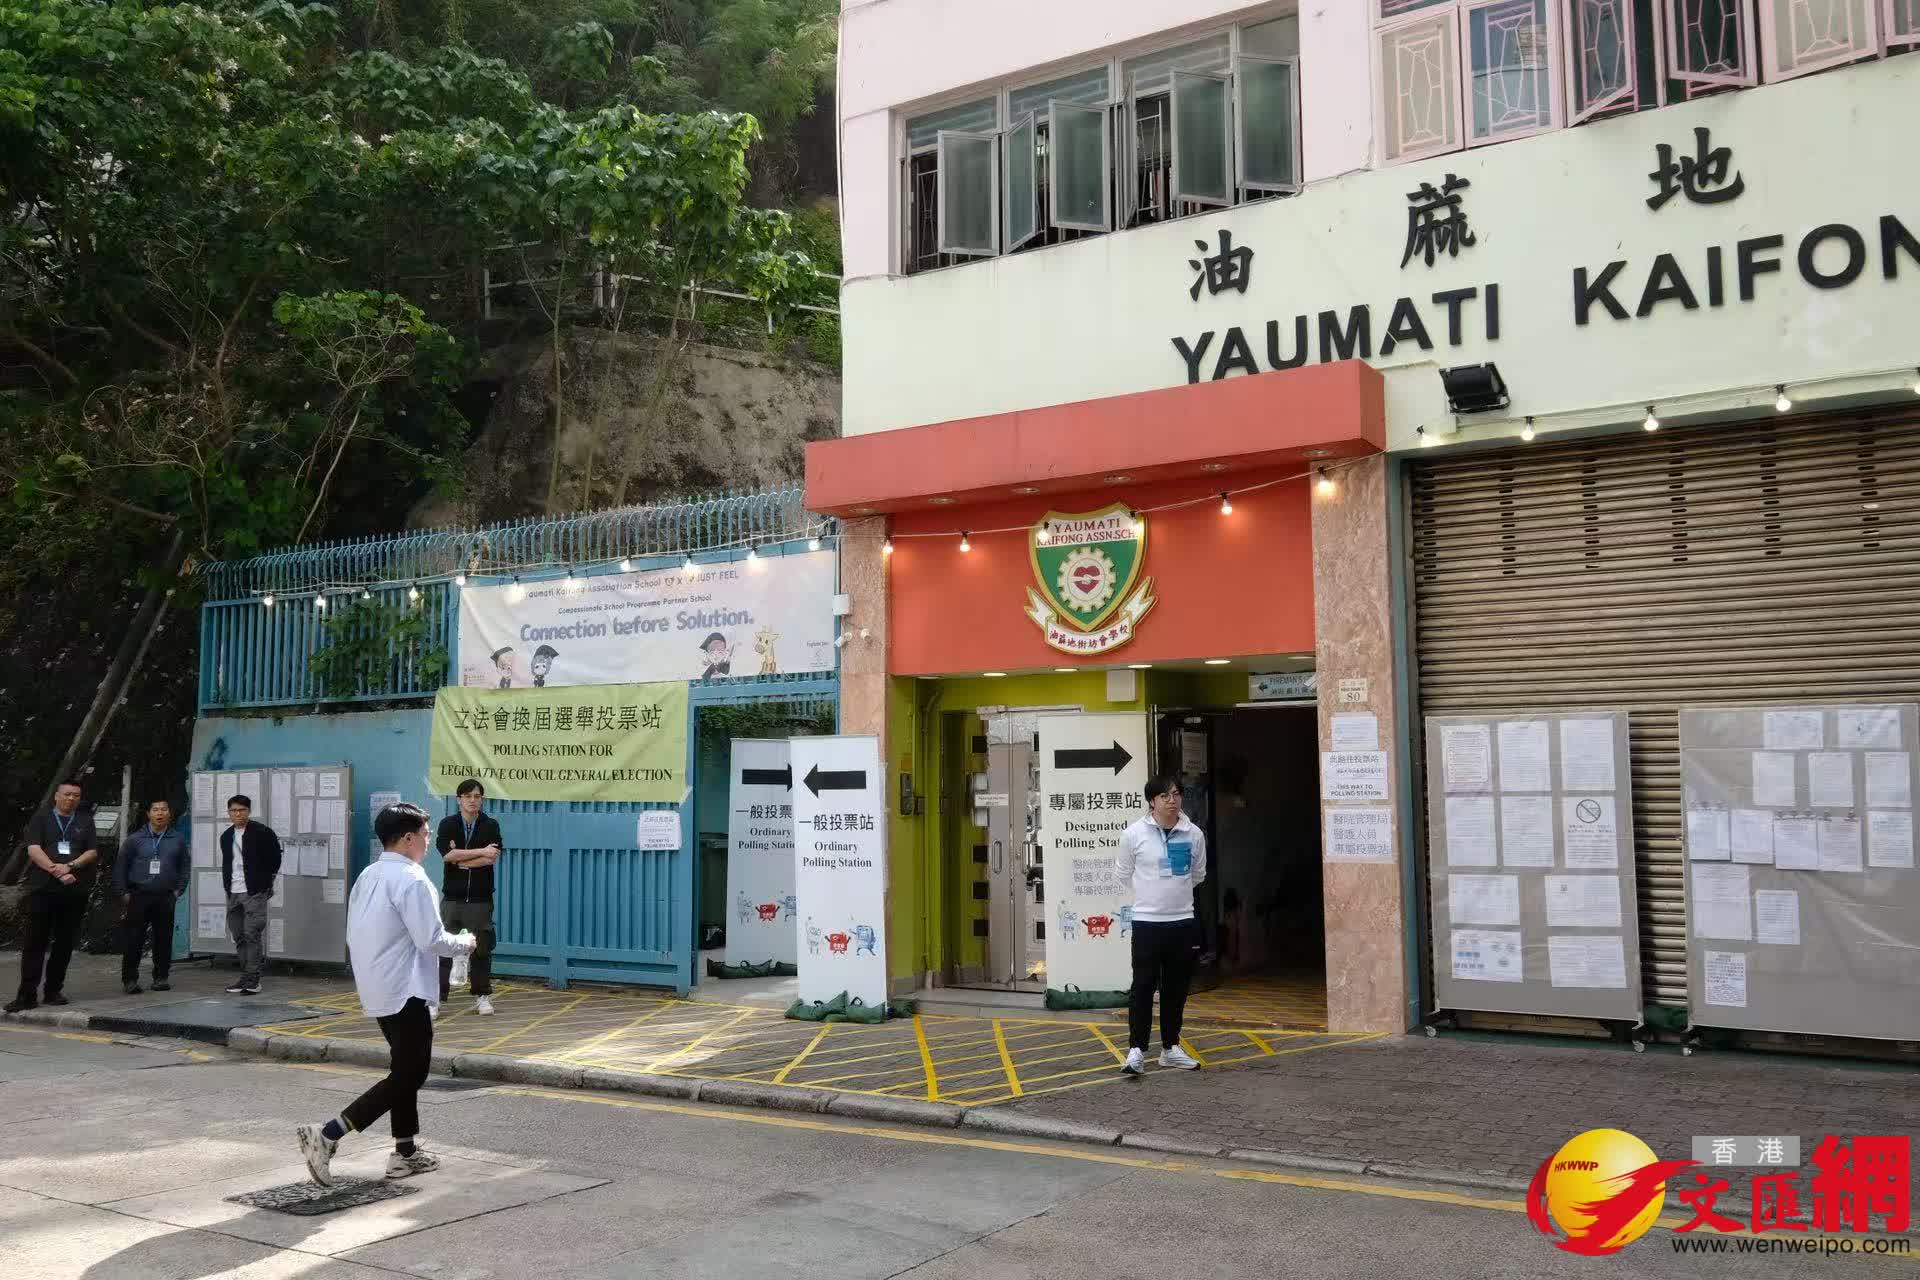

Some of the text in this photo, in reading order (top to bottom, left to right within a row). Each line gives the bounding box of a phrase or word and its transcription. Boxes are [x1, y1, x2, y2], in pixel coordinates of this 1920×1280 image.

[1171, 283, 1500, 383] YAUMATI
[1054, 518, 1121, 534] YAUMATI
[526, 588, 554, 599] aumati
[635, 579, 661, 589] School
[719, 571, 739, 581] FEEL
[604, 602, 625, 611] School
[626, 600, 661, 609] Programme
[663, 597, 688, 605] Partner
[690, 594, 712, 603] School
[520, 607, 755, 642] Connection before Solution.
[454, 704, 663, 731] 立法會換屆選舉投票站
[493, 744, 613, 757] POLLING STATION FOR
[441, 764, 673, 781] LEGISLATIVE COUNCIL GENERAL ELECTION
[1049, 791, 1142, 811] 專屬投票站
[799, 813, 874, 831] 一般投票站
[1065, 820, 1128, 834] Designated
[750, 827, 791, 838] Ordinary
[738, 840, 769, 850] Polling
[814, 841, 858, 854] Ordinary
[1055, 837, 1095, 850] Polling
[803, 857, 872, 869] Polling Station
